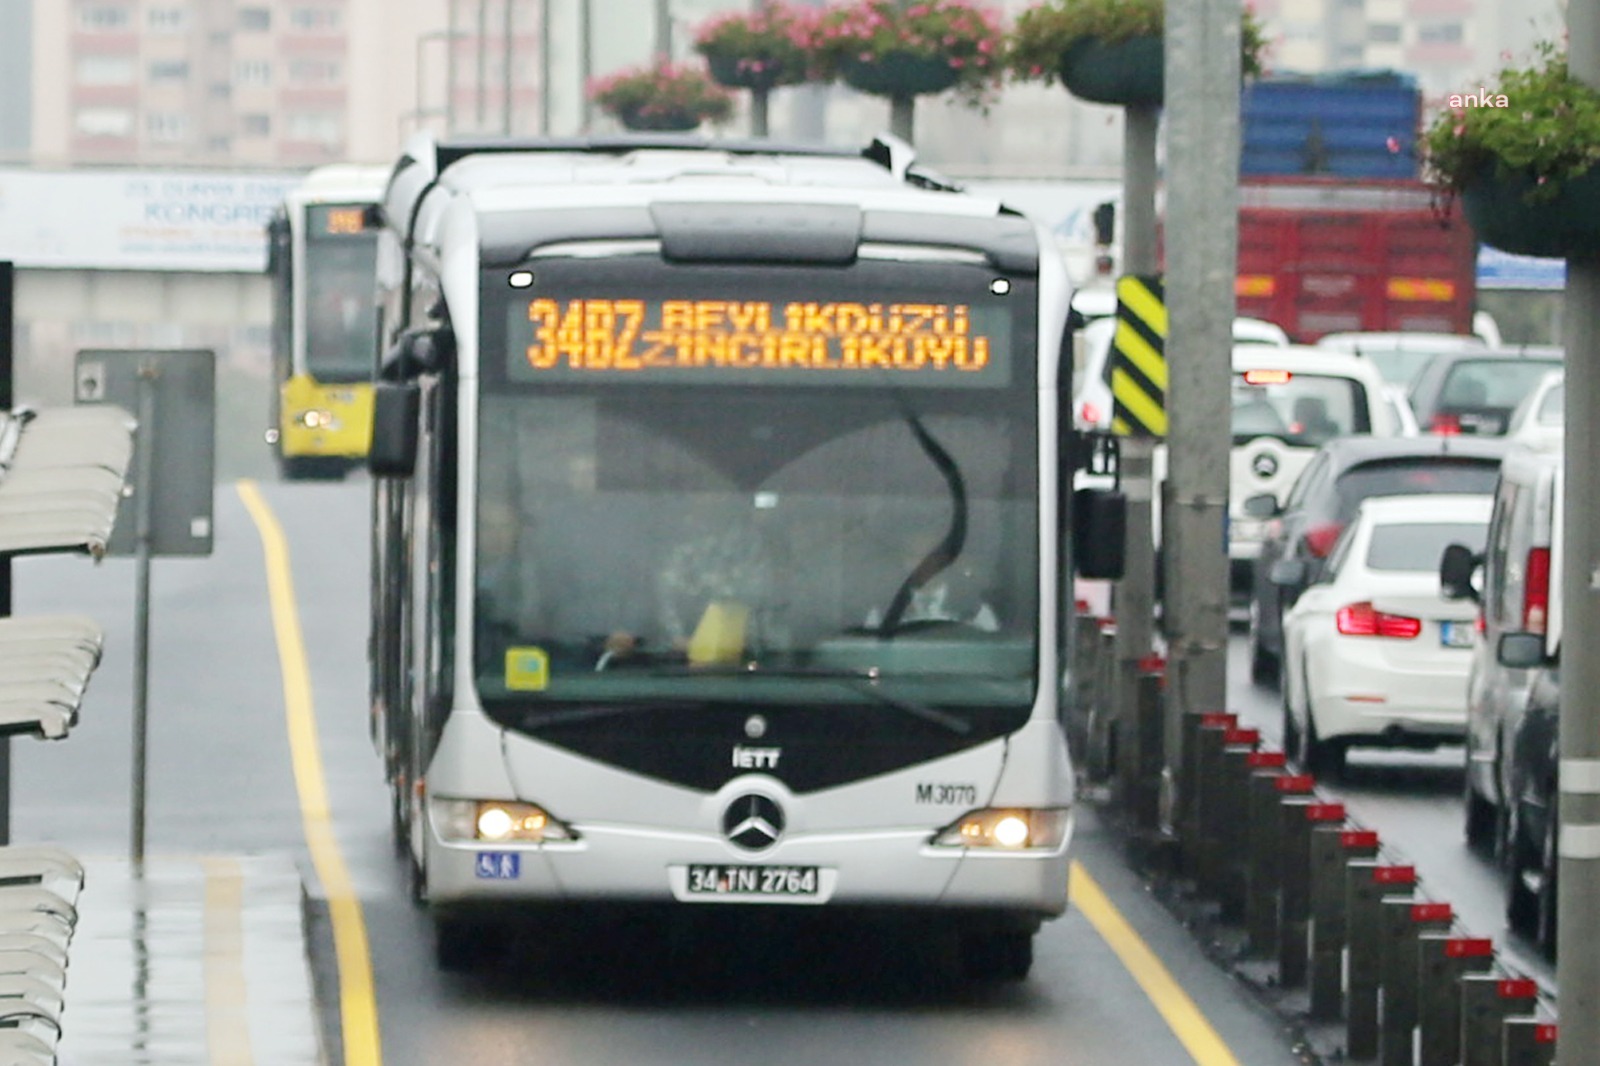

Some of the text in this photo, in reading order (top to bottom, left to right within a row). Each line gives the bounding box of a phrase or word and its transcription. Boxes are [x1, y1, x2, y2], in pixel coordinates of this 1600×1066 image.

[690, 868, 817, 894] 34 TN 2764
